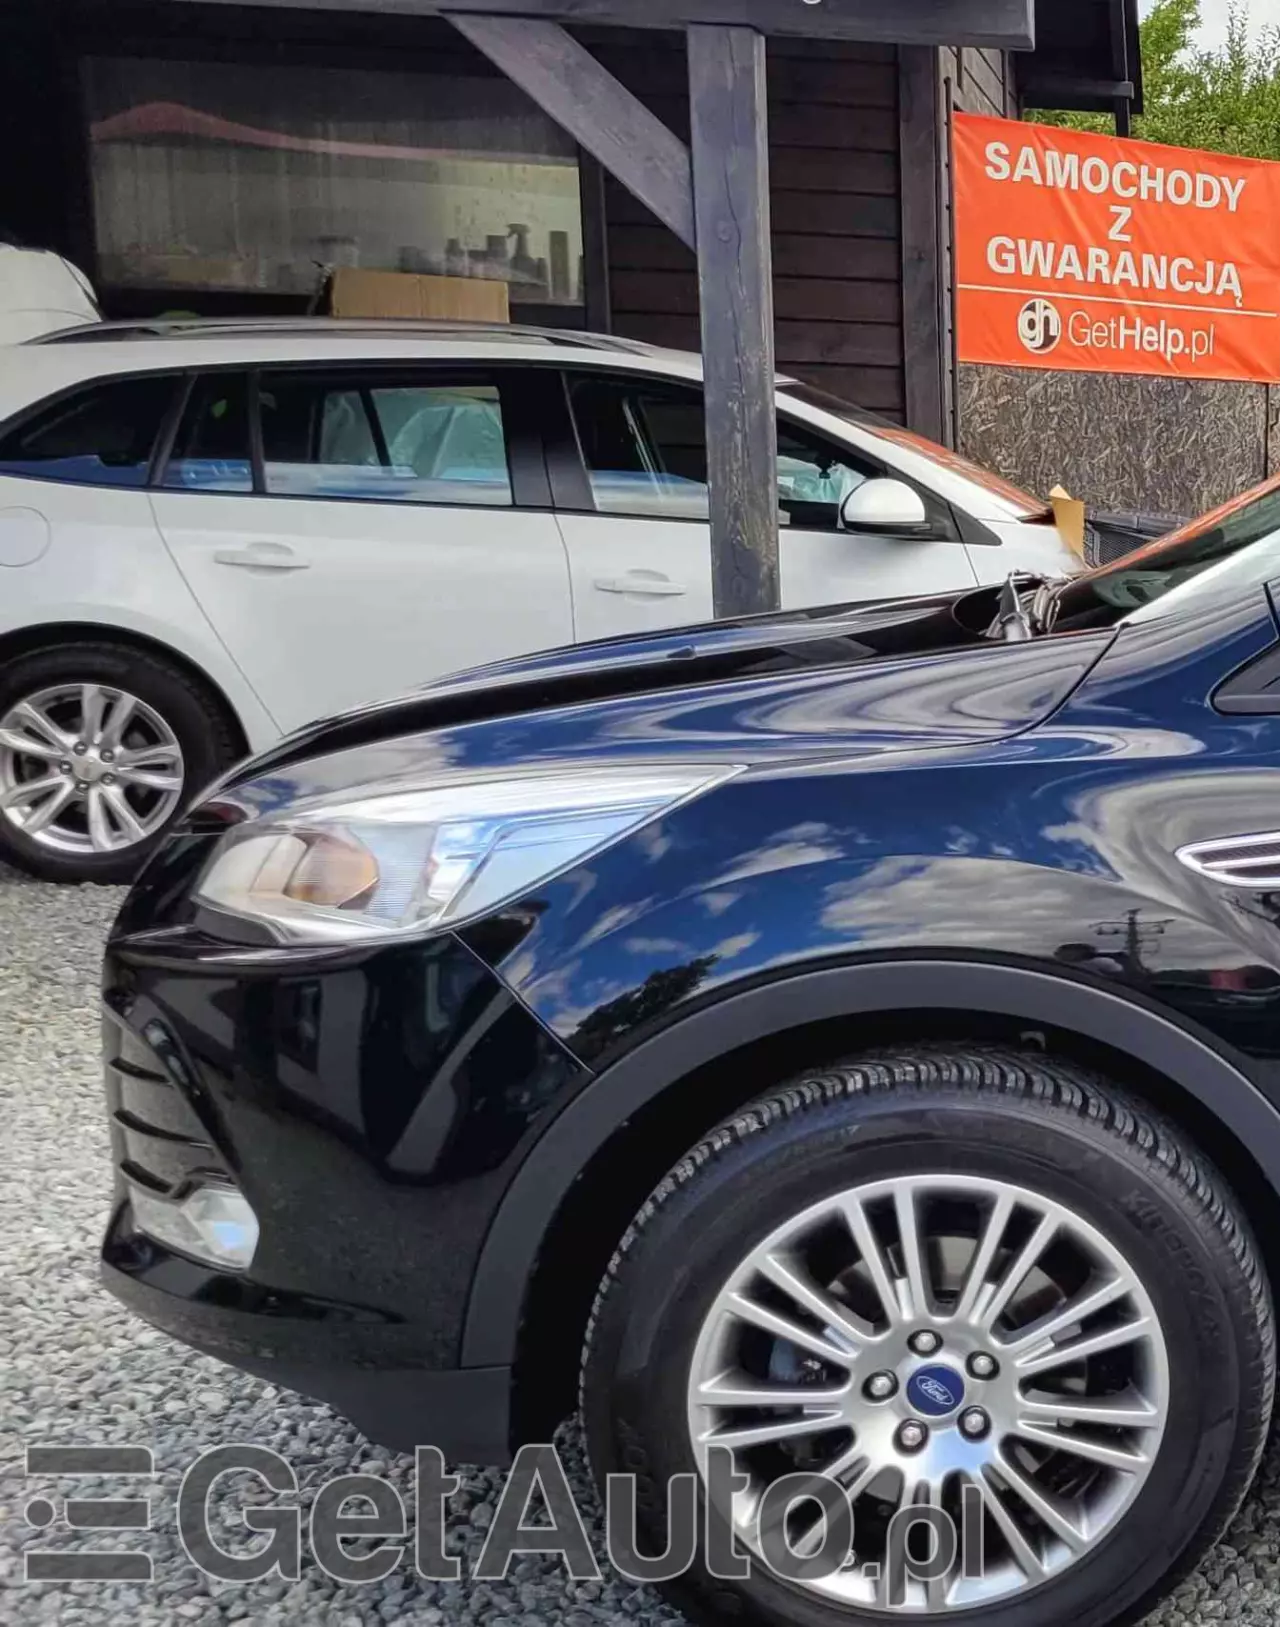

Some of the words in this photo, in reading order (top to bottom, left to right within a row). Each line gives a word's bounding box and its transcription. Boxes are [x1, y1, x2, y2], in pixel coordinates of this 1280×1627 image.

[984, 141, 1246, 212] SAMOCHODY
[1108, 205, 1132, 242] Z
[986, 236, 1243, 307] GWARANCJĄ
[1068, 310, 1215, 362] GetHelp.pl
